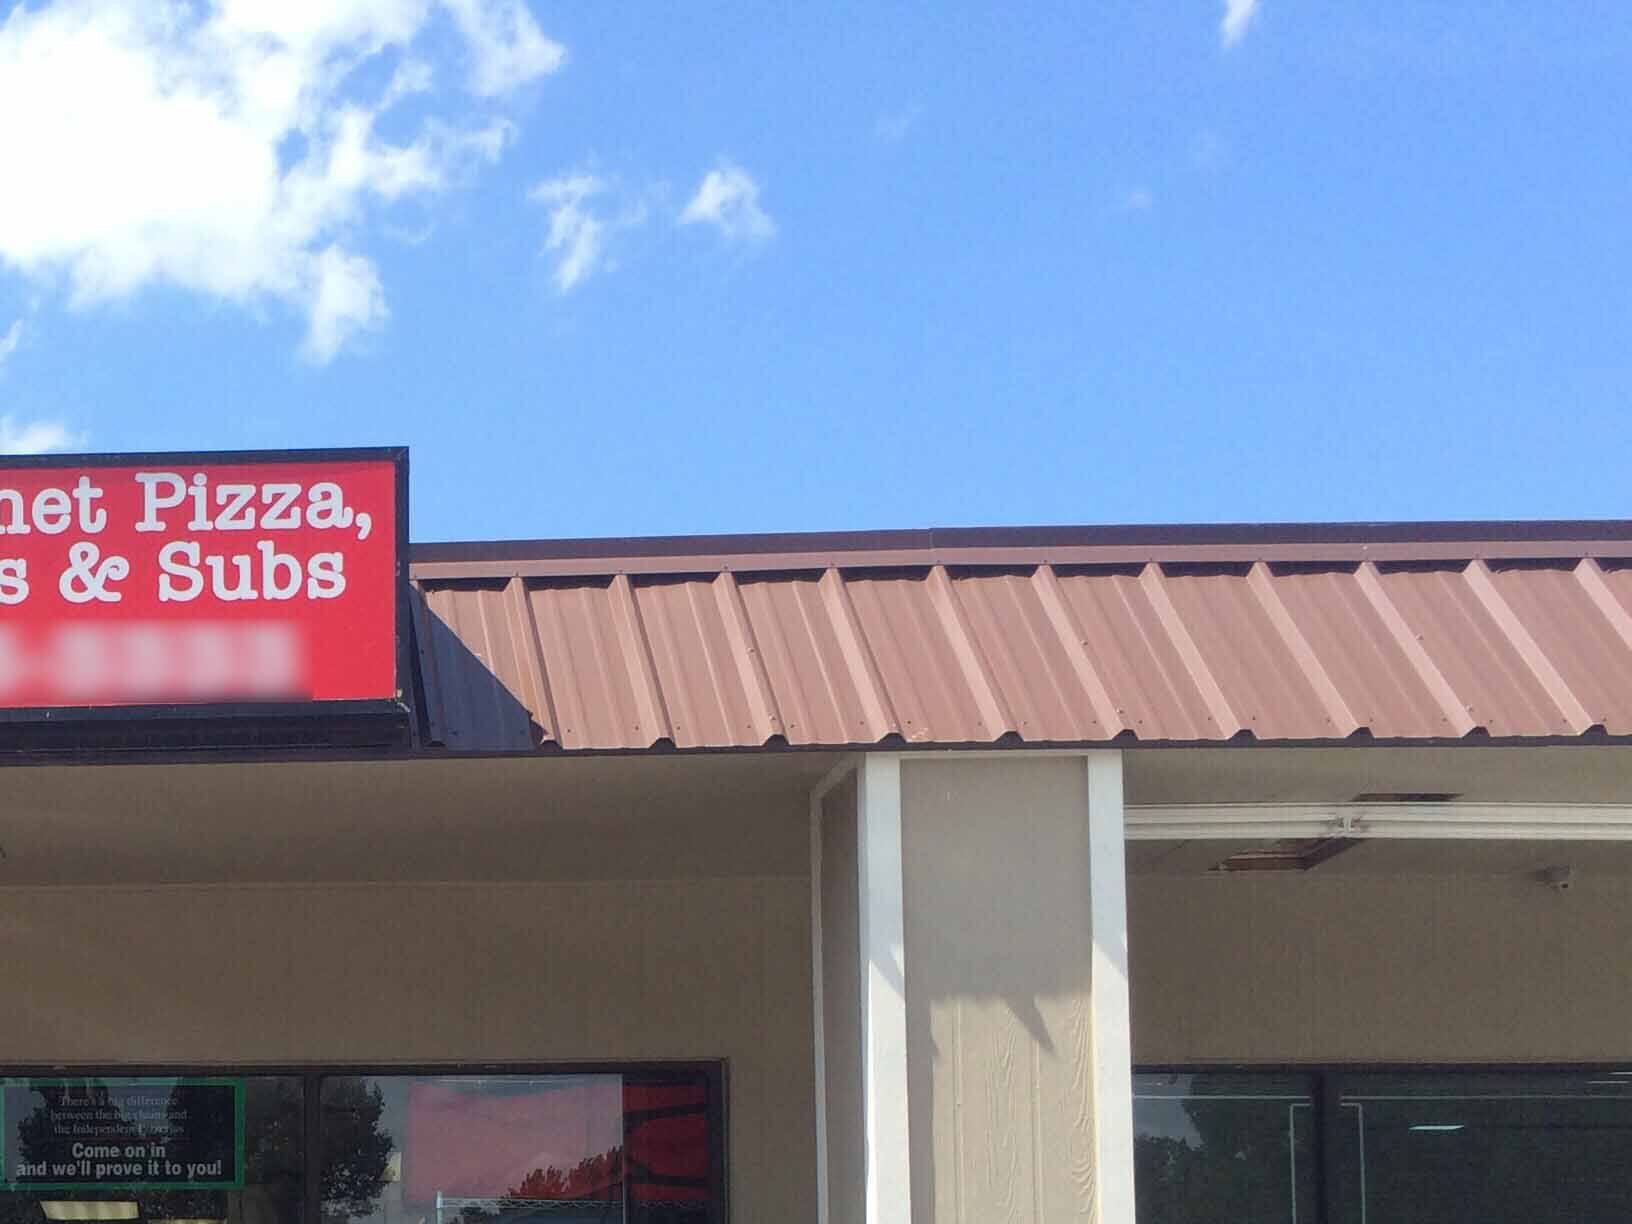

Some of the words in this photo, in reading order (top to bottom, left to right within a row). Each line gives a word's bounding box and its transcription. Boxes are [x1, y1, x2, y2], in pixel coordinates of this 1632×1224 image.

[135, 471, 372, 540] Pizza,
[59, 542, 129, 603] &
[158, 540, 346, 602] Subs
[16, 1160, 47, 1176] and
[52, 1160, 91, 1176] we'll
[95, 1163, 143, 1179] prove
[148, 1160, 160, 1176] it
[165, 1160, 181, 1176] to
[187, 1160, 223, 1179] you!
[71, 1143, 121, 1158] Come
[125, 1146, 145, 1158] on
[150, 1142, 166, 1158] in
